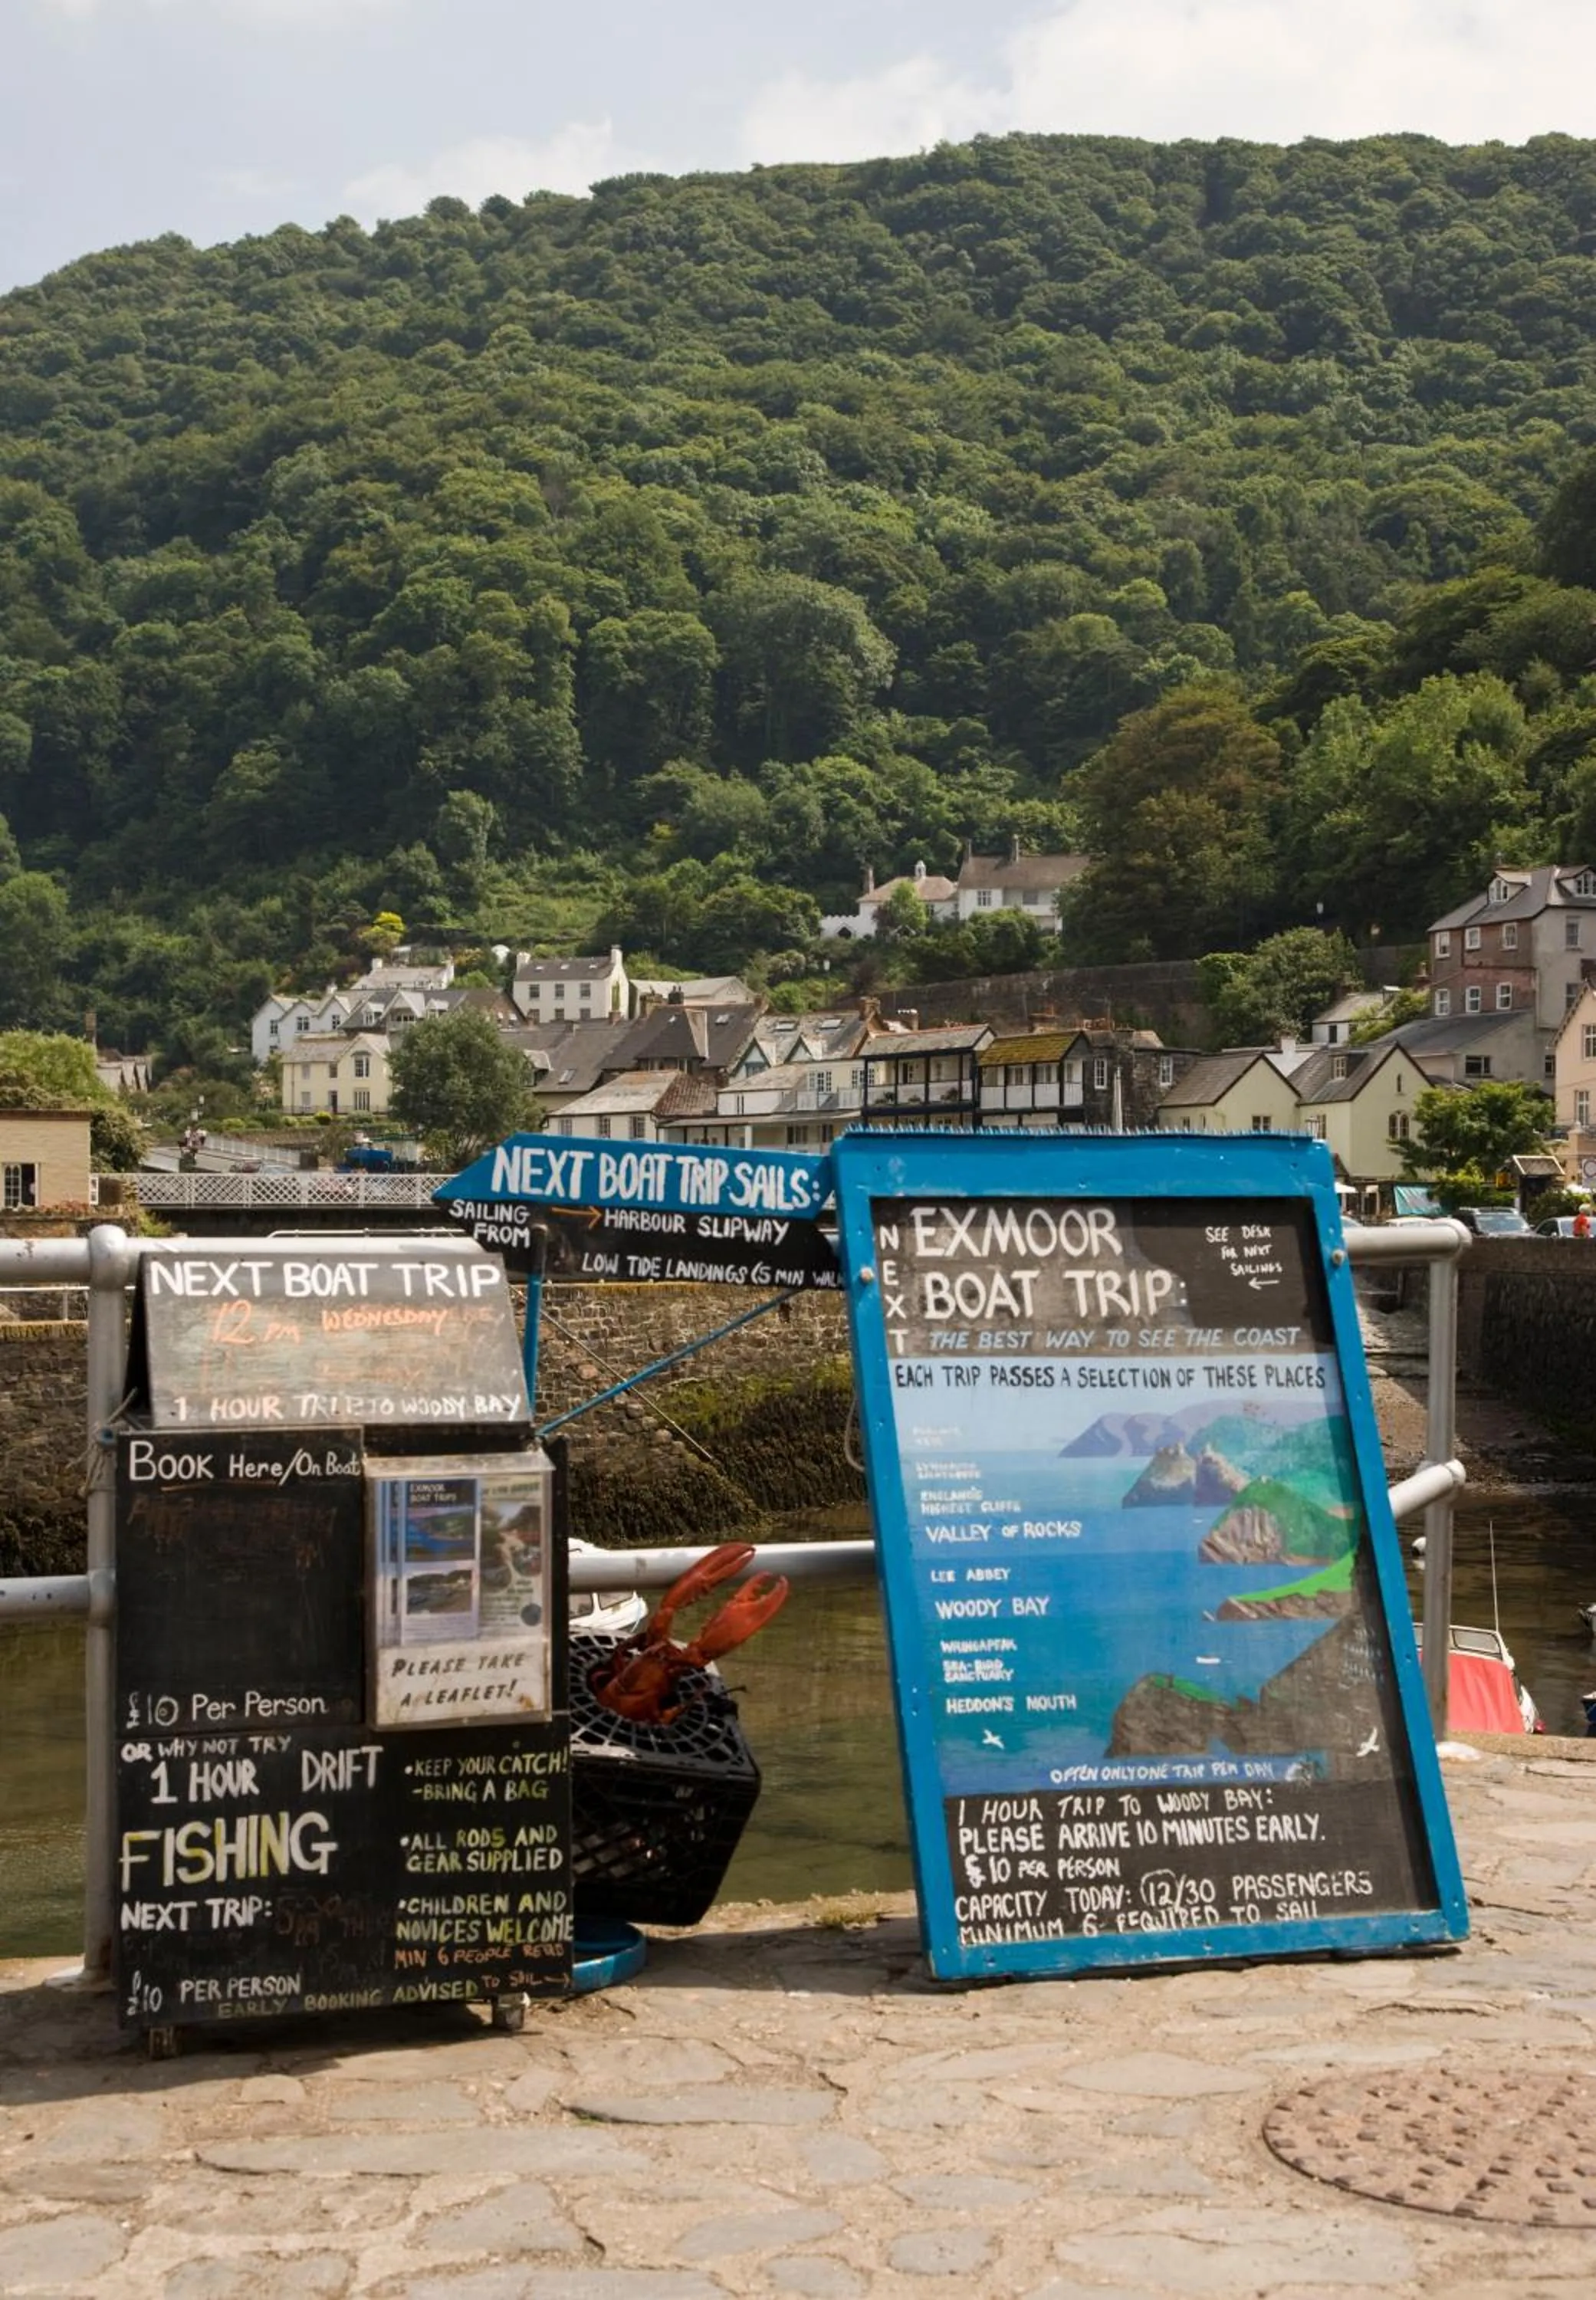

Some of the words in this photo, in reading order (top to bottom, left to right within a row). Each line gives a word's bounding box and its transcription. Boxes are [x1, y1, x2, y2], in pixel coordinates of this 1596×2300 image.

[491, 1146, 594, 1200] NEXT
[598, 1152, 674, 1201] BOAT
[676, 1155, 728, 1204] TRIP
[729, 1162, 821, 1210] SAILS:
[448, 1199, 530, 1224] SAILING
[474, 1222, 530, 1248] FROM
[604, 1208, 686, 1233] HARBOUR
[697, 1215, 790, 1245] SLIPWAY
[910, 1207, 1122, 1257] EXMOOR
[1205, 1226, 1229, 1243] SEE
[1242, 1224, 1271, 1239] DESK
[1220, 1245, 1238, 1260] FOR
[1243, 1244, 1273, 1257] NEXT
[149, 1261, 274, 1297] NEXT
[282, 1262, 379, 1297] BOAT
[391, 1263, 501, 1298] TRIP
[581, 1252, 619, 1274] LOW
[626, 1255, 662, 1278] TIDE
[665, 1258, 748, 1285] LANDINGS
[751, 1260, 770, 1285] (5
[775, 1269, 804, 1285] MIN
[1230, 1262, 1282, 1276] SAILINGS
[924, 1270, 1041, 1319] BOAT
[1062, 1268, 1187, 1319] TRIP:
[212, 1300, 255, 1343] 12
[321, 1307, 448, 1336] WEDNESDAY
[929, 1329, 970, 1349] THE
[977, 1329, 1033, 1349] BEST
[1045, 1329, 1096, 1349] WAY
[1106, 1329, 1131, 1348] TO
[1138, 1329, 1177, 1348] SEE
[1185, 1328, 1223, 1347] THE
[1233, 1327, 1301, 1346] COAST
[895, 1364, 933, 1388] EACH
[941, 1365, 981, 1387] TRIP
[990, 1365, 1055, 1388] PASSES
[1061, 1366, 1071, 1387] A
[1077, 1365, 1171, 1388] SELECTION
[1177, 1368, 1196, 1388] OF
[1203, 1365, 1258, 1388] THESE
[1264, 1364, 1325, 1388] PLACES
[173, 1396, 187, 1421] 1
[209, 1396, 284, 1422] HOUR
[291, 1393, 365, 1420] TRIP
[367, 1397, 395, 1416] TO
[401, 1395, 467, 1422] WOODY
[473, 1394, 521, 1421] BAY
[326, 1451, 361, 1477] Boat
[410, 1484, 445, 1492] EXMOOR
[925, 1523, 993, 1544] VALLEY
[1001, 1525, 1019, 1538] OF
[1023, 1520, 1082, 1539] ROCKS
[931, 1569, 956, 1583] LEE
[966, 1567, 1011, 1582] ABBEY
[934, 1598, 1003, 1620] WOODY
[1012, 1595, 1050, 1616] BAY
[391, 1657, 467, 1677] PLEASE
[478, 1652, 527, 1671] TAKE
[192, 1693, 236, 1722] Per
[245, 1690, 328, 1718] Person
[400, 1692, 412, 1707] A
[425, 1678, 518, 1706] LEAFLET!
[1026, 1694, 1077, 1711] MOUTH
[121, 1742, 153, 1763] OR
[157, 1737, 197, 1758] WHY
[202, 1737, 239, 1755] NOT
[248, 1735, 292, 1754] TRY
[414, 1758, 452, 1777] KEEP
[457, 1756, 496, 1776] YOUR
[499, 1746, 568, 1776] CATCH!
[150, 1761, 178, 1804] 1
[189, 1758, 260, 1802] HOUR
[301, 1745, 383, 1792] DRIFT
[1050, 1764, 1098, 1784] OFTEN
[1101, 1766, 1136, 1782] ONLY
[1137, 1763, 1169, 1780] ONE
[1172, 1764, 1204, 1779] TRIP
[1211, 1761, 1238, 1776] PER
[1244, 1762, 1276, 1779] DAY
[482, 1779, 497, 1802] A
[504, 1779, 549, 1802] BAG
[981, 1798, 1043, 1825] HOUR
[1057, 1795, 1107, 1819] TRIP
[1118, 1794, 1141, 1816] TO
[1156, 1791, 1210, 1814] WOODY
[1223, 1788, 1273, 1811] BAY:
[410, 1832, 448, 1852] ALL
[455, 1827, 506, 1848] RODS
[514, 1824, 558, 1847] AND
[958, 1824, 1046, 1856] PLEASE
[1058, 1822, 1131, 1851] ARRIVE
[1136, 1819, 1158, 1847] 10
[1162, 1815, 1250, 1847] MINUTES
[1256, 1812, 1325, 1844] EARLY.
[119, 1811, 339, 1893] FISHING
[406, 1851, 463, 1873] GEAR
[467, 1847, 563, 1872] SUPPLIED
[1018, 1859, 1049, 1879] PER
[1057, 1856, 1121, 1881] PERSON
[407, 1894, 511, 1914] CHILDREN
[517, 1890, 567, 1913] AND
[955, 1889, 1048, 1922] CAPACITY
[1065, 1884, 1132, 1914] TODAY:
[1232, 1869, 1373, 1901] PASSENGERS
[120, 1901, 197, 1932] NEXT
[205, 1895, 272, 1930] TRIP:
[958, 1917, 1064, 1946] MINIMUM
[1230, 1903, 1261, 1925] TO
[396, 1917, 482, 1943] NOVICES
[486, 1914, 574, 1945] WELCOME
[394, 1949, 427, 1970] MIN
[437, 1946, 449, 1966] 6
[453, 1946, 511, 1964] PEOPLE
[180, 1979, 222, 2004] PER
[227, 1973, 302, 1999] PERSON
[481, 1974, 501, 1988] TO
[218, 1998, 288, 2019] EARLY
[304, 1989, 383, 2011] BOOKING
[392, 1978, 478, 2003] ADVISED
